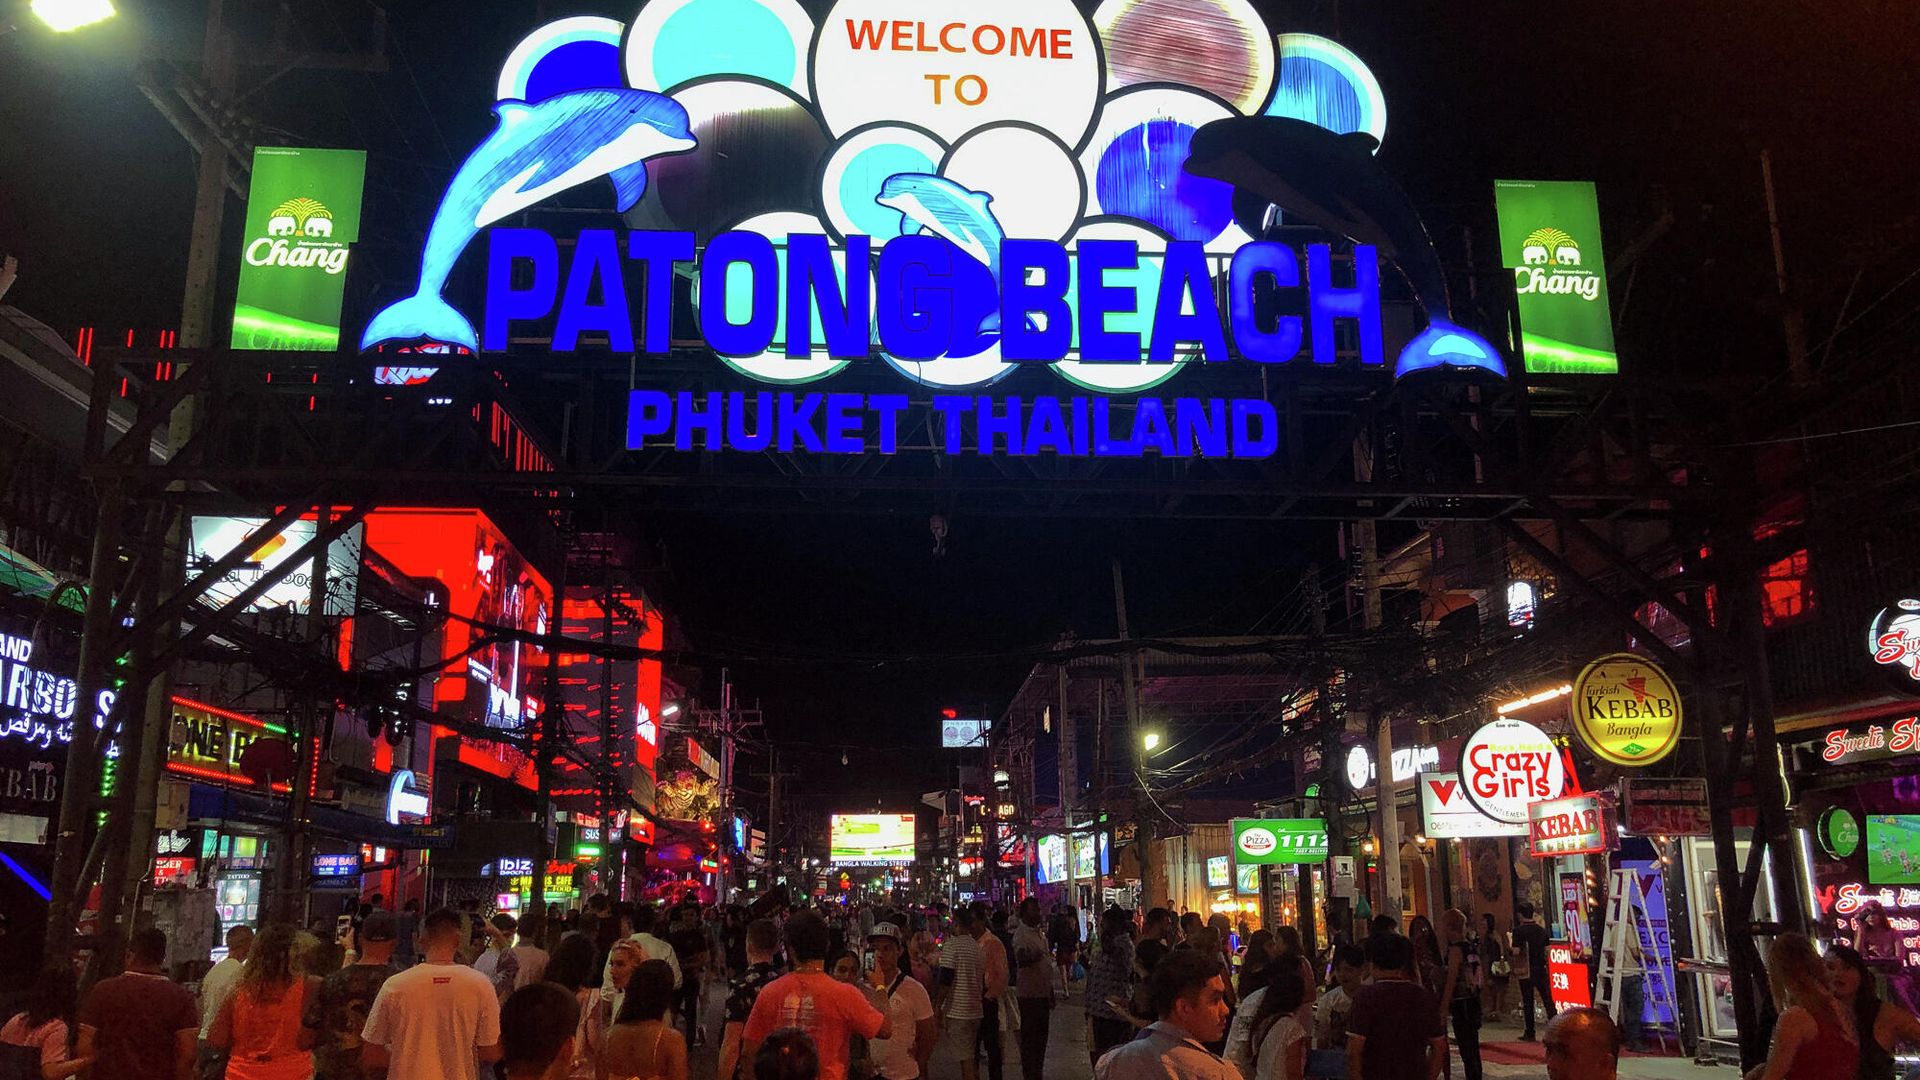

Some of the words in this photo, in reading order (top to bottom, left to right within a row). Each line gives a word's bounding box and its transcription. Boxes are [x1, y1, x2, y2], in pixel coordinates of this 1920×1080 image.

[845, 18, 1073, 60] WELCOME
[924, 74, 988, 106] TO
[246, 237, 349, 275] Chang
[483, 228, 952, 361] PATONG
[1000, 238, 1385, 365] BEACH
[1515, 266, 1601, 301] Chang
[625, 390, 909, 455] PHUKET
[933, 395, 1279, 459] THAILAND
[1586, 684, 1620, 696] Turkish
[1587, 696, 1673, 720] KEBAB
[1606, 722, 1653, 740] Bangla
[1823, 725, 1884, 762] Sweetie
[1470, 744, 1551, 779] Crazy
[1473, 769, 1550, 799] Girls
[1245, 836, 1270, 845] PIZZA
[1533, 808, 1599, 841] KEBAB
[500, 858, 534, 871] Ibiz
